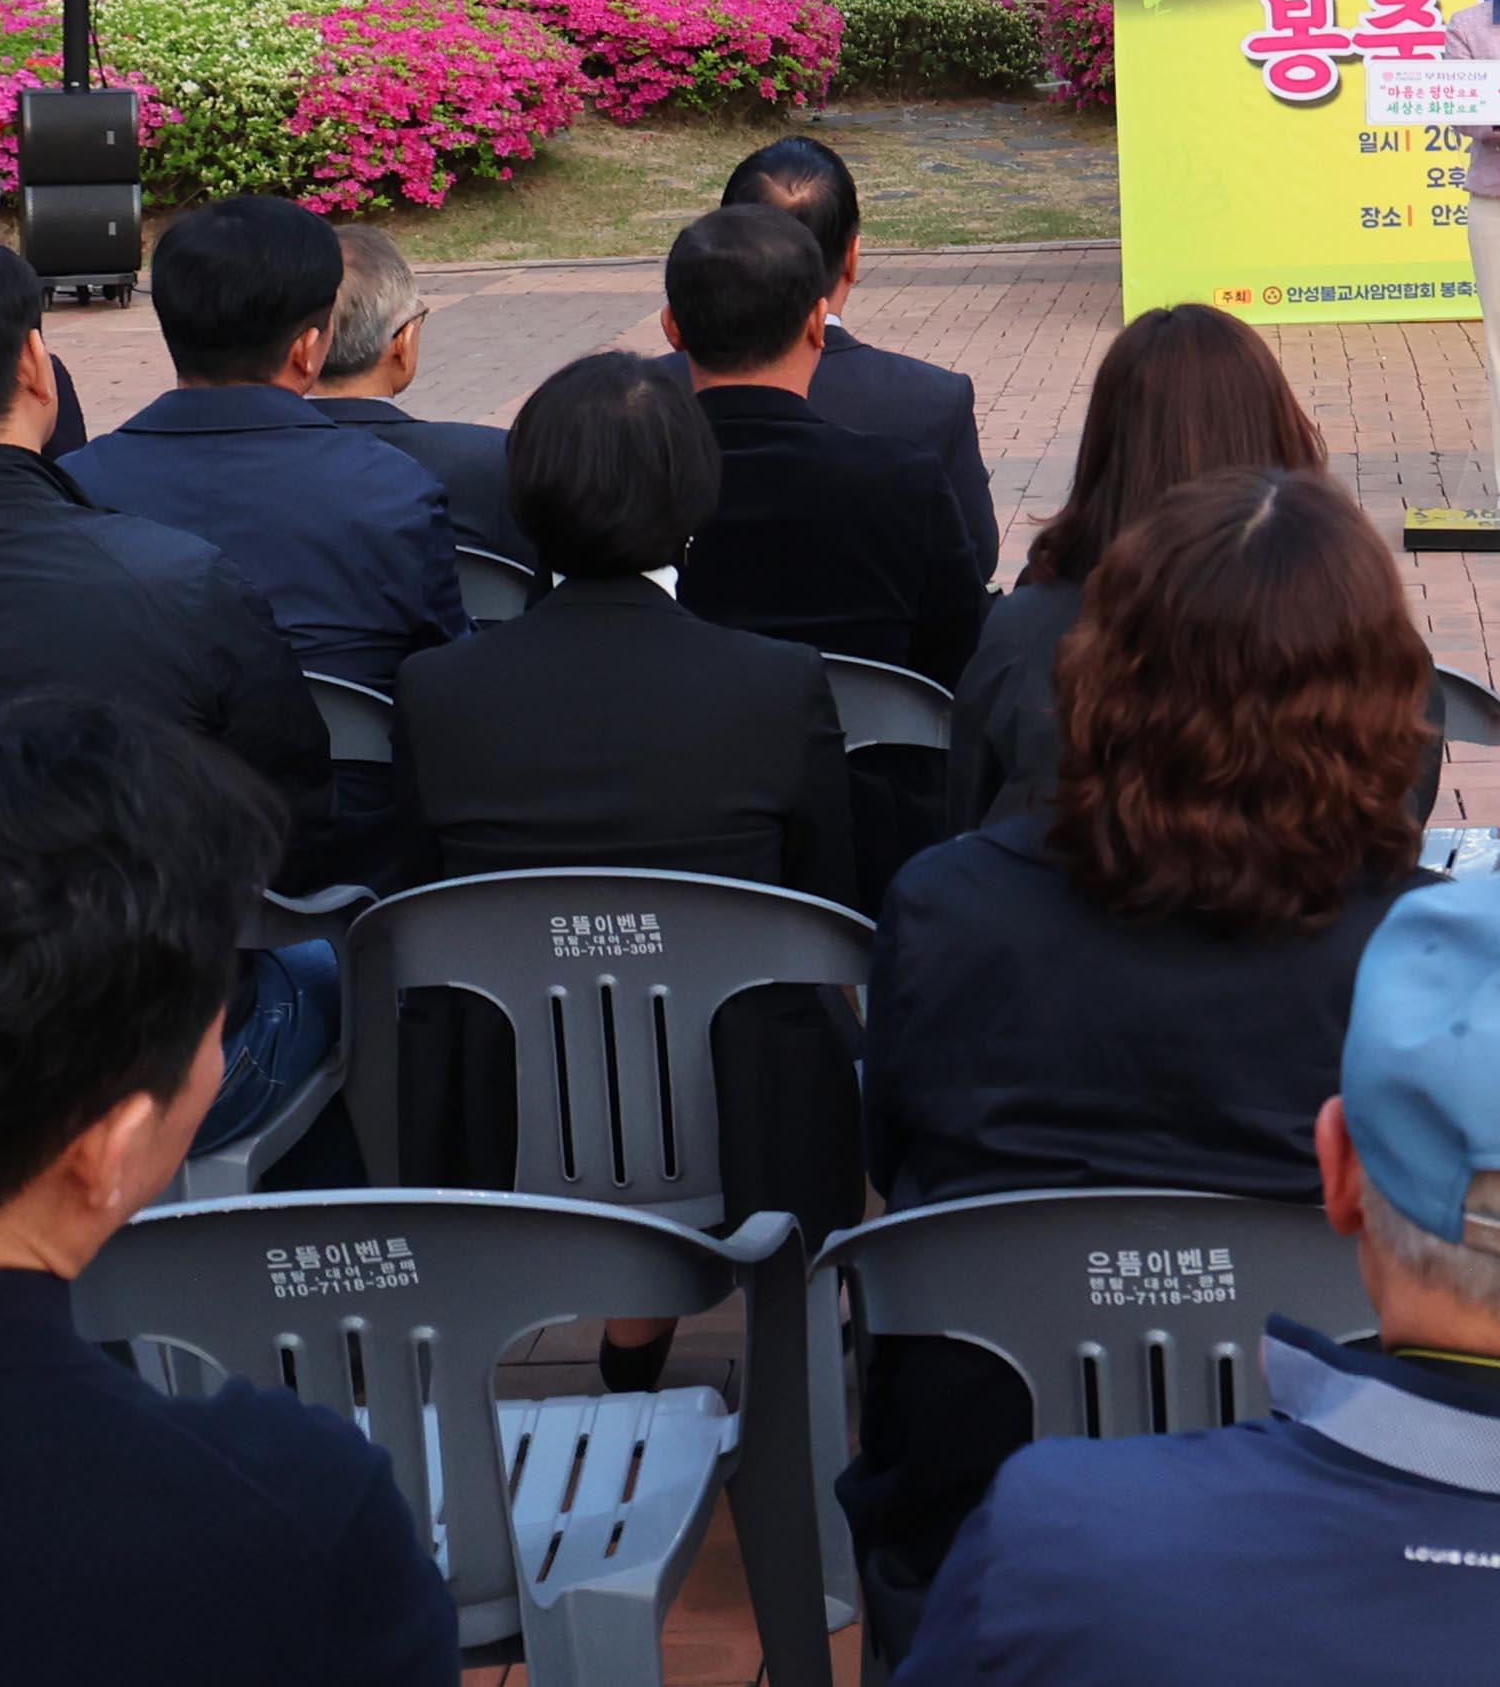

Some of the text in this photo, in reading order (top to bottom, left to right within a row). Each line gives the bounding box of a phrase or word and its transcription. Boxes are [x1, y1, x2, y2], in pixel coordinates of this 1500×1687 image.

[1358, 131, 1399, 153] 일시
[1426, 167, 1466, 189] 오후
[1360, 206, 1402, 229] 장소
[1286, 281, 1435, 303] 안성불교사암연합회
[550, 912, 660, 935] 으뜸이벤트
[554, 941, 664, 958] 010-7118-3091
[265, 1237, 414, 1270] 으뜸이벤트
[1087, 1247, 1235, 1278] 으뜸이벤트
[273, 1272, 420, 1299] 010-7118-3091
[1090, 1287, 1237, 1306] 010-7118-3091
